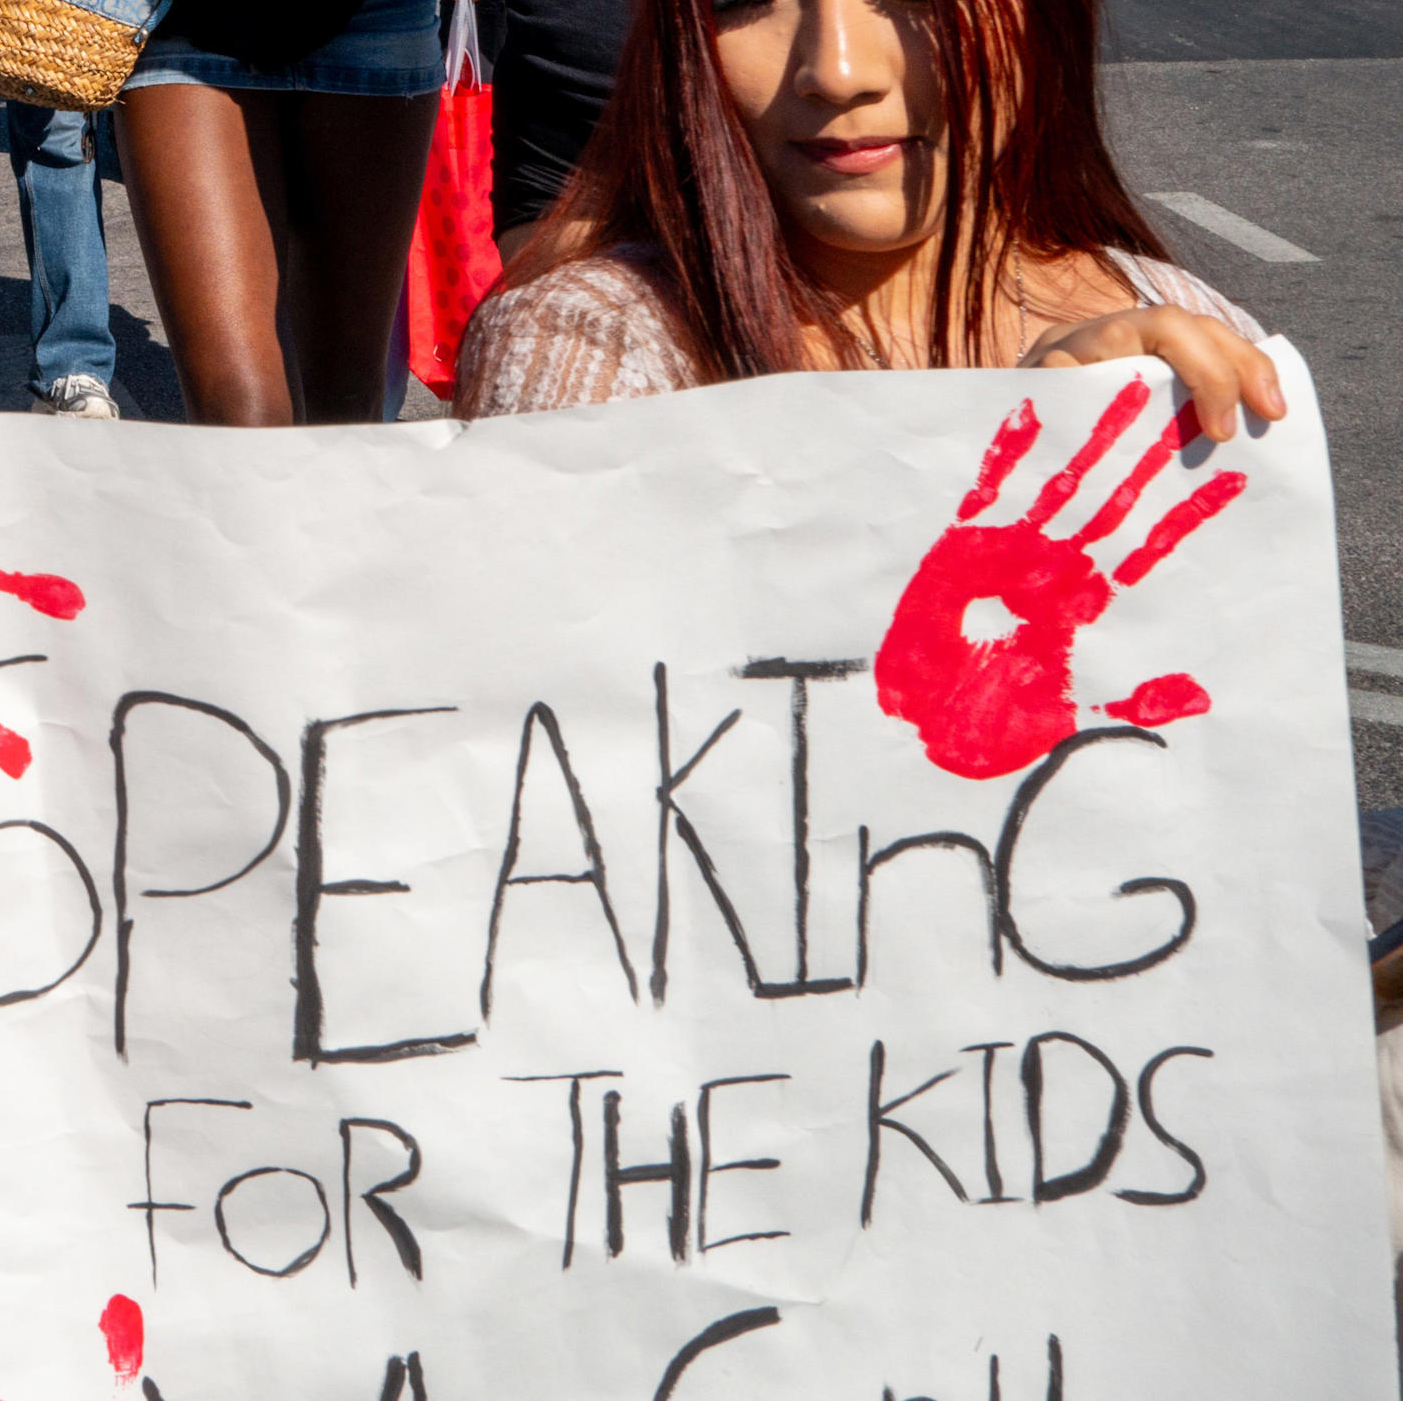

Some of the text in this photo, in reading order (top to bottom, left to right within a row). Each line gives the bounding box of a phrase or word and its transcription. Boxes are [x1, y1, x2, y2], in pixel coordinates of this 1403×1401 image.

[126, 1030, 1215, 1289] FOR THE KIDS
